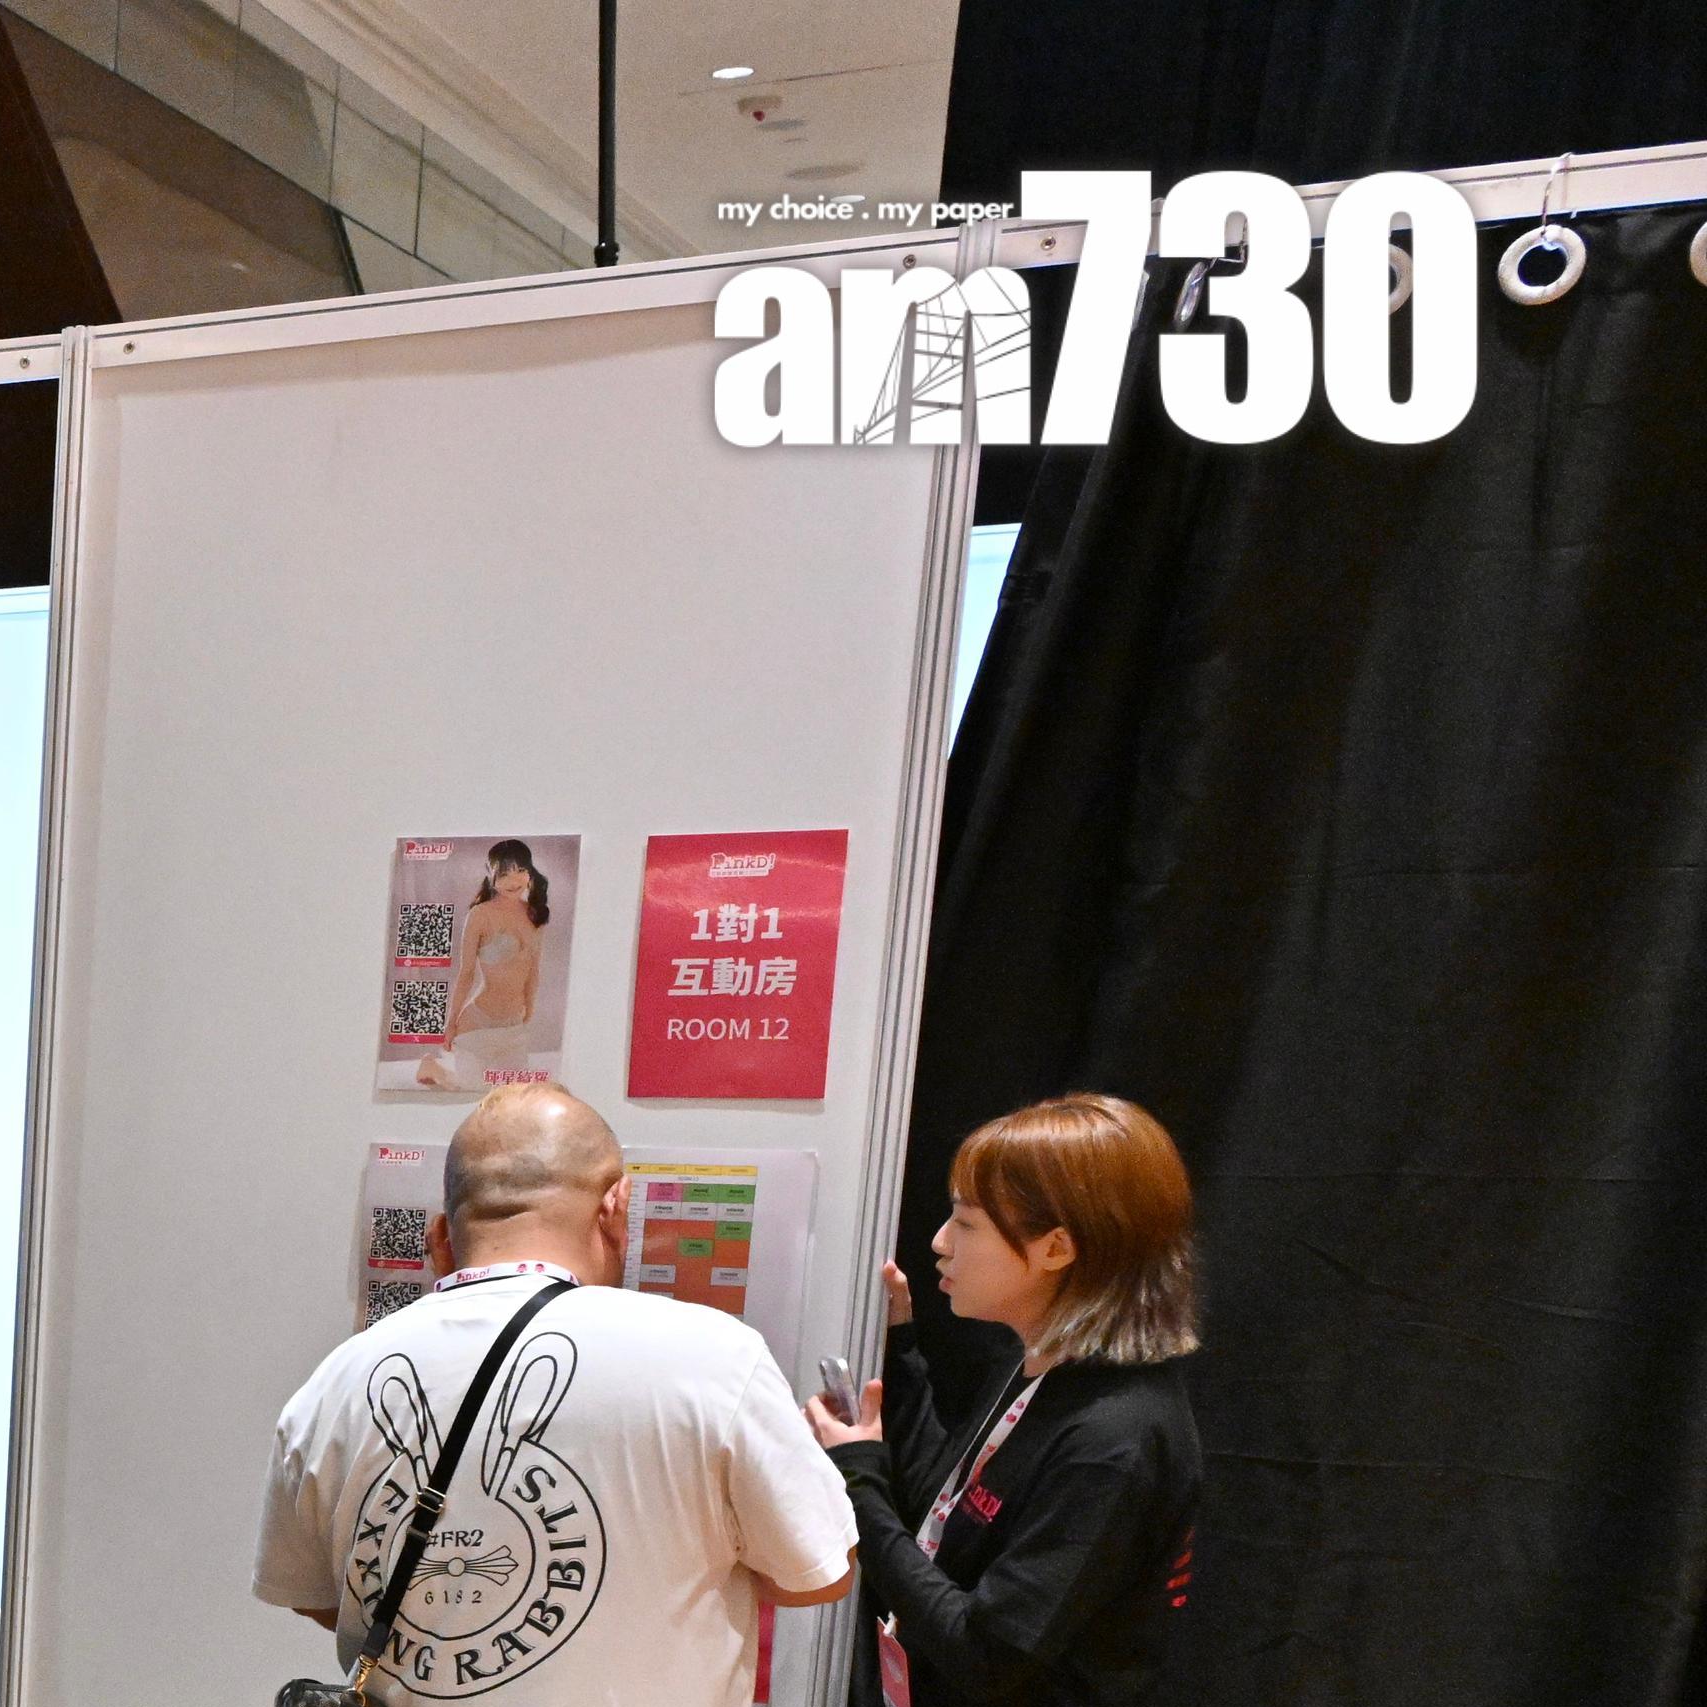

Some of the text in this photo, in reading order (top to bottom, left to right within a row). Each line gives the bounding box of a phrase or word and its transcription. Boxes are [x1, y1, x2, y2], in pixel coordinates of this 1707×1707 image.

[691, 903, 784, 944] 1對1
[668, 955, 797, 998] 互動房
[667, 1017, 790, 1041] ROOM 12
[379, 1147, 425, 1160] PinkD!
[427, 1529, 483, 1548] #FR2
[455, 1463, 589, 1687] RABBITS
